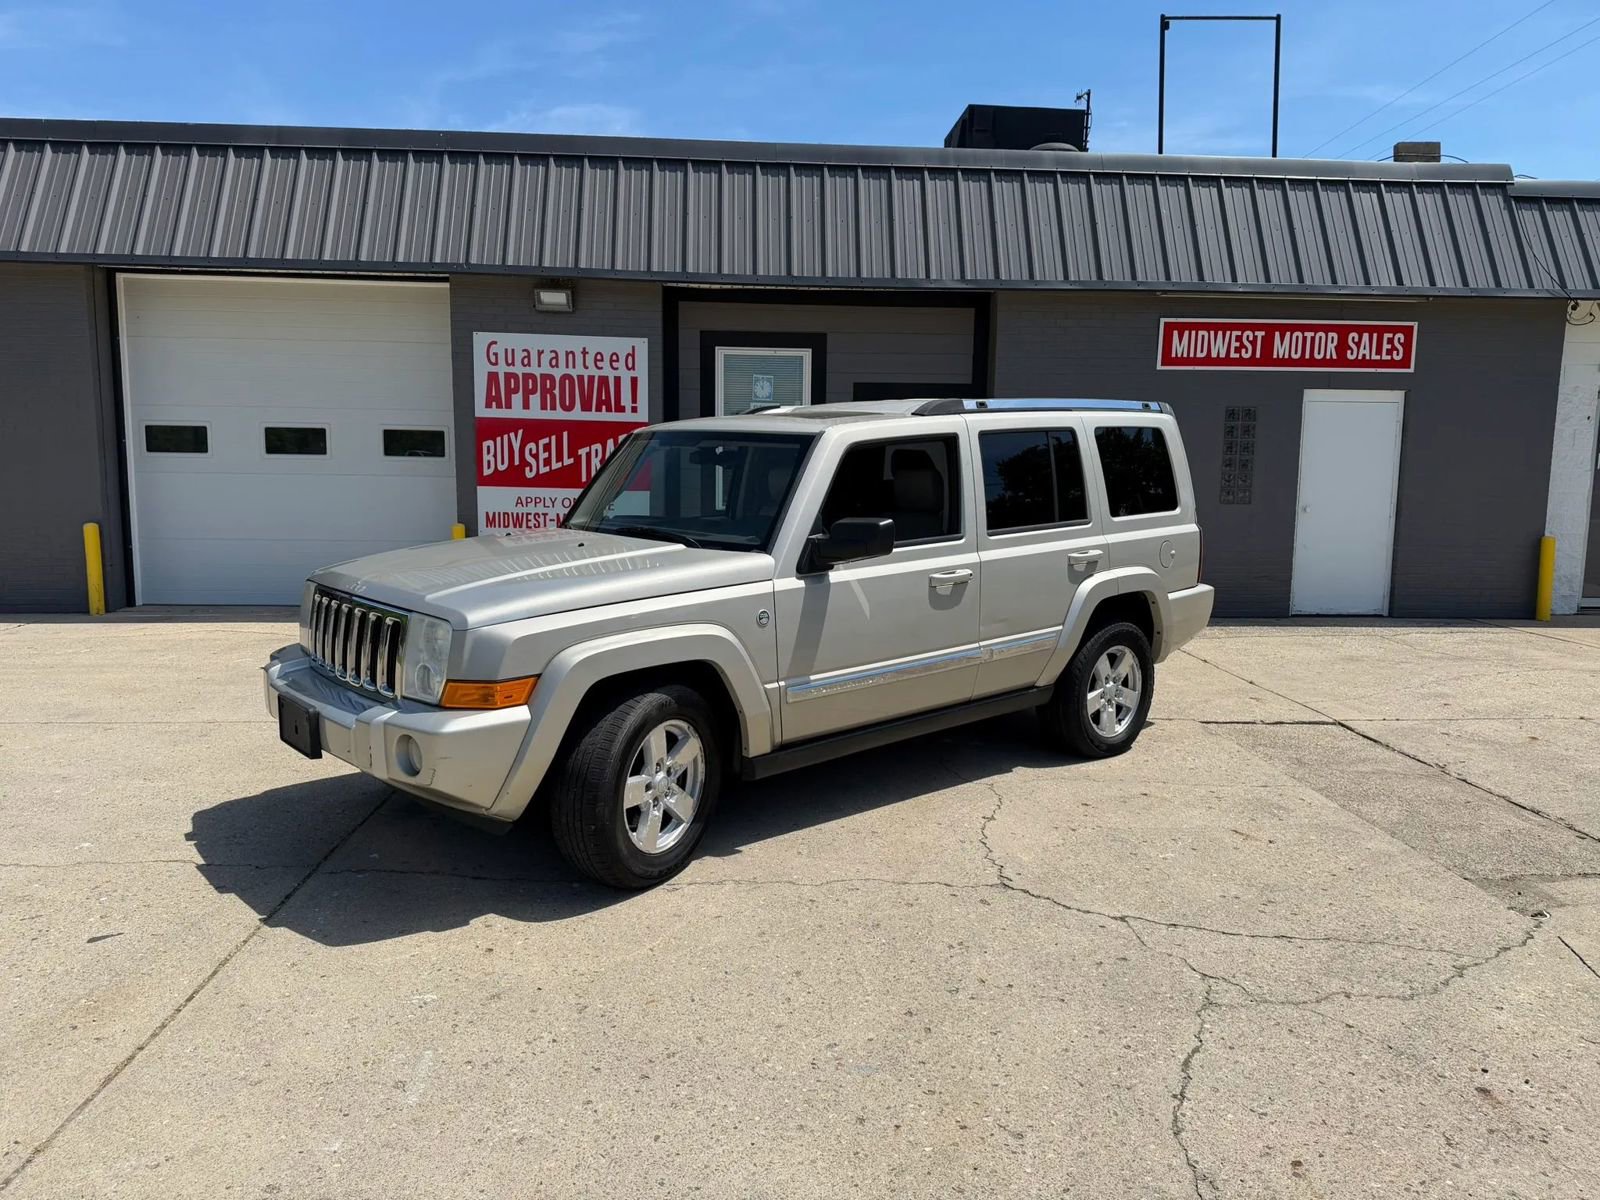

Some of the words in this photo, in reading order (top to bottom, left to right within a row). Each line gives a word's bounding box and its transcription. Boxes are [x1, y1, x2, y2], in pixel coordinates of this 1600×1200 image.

[486, 340, 636, 371] Guaranteed
[1171, 330, 1265, 359] MIDWEST
[1273, 331, 1337, 360] MOTOR
[1346, 332, 1405, 361] SALES
[485, 371, 638, 413] APPROVAL!
[482, 428, 523, 477] BUY
[524, 430, 575, 479] SELL
[577, 433, 627, 482] TRA
[515, 496, 558, 508] APPLY
